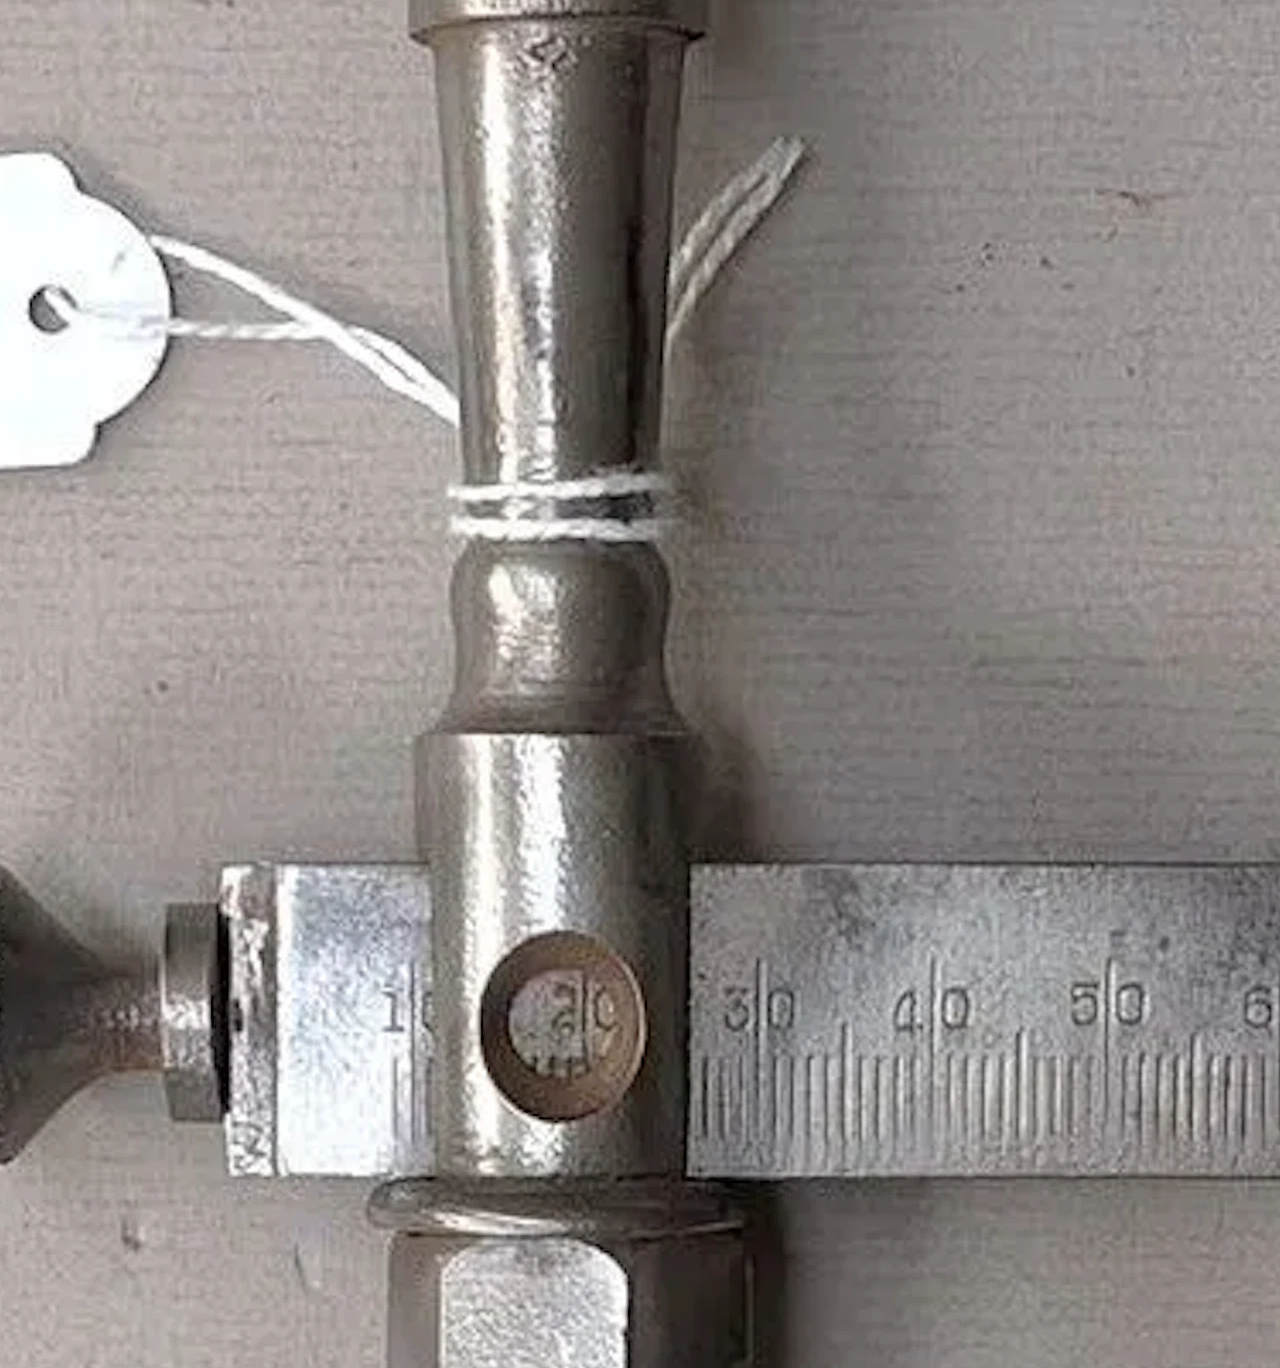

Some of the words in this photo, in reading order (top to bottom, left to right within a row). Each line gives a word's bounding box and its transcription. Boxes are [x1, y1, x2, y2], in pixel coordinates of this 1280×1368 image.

[724, 986, 794, 1030] 30
[893, 987, 970, 1032] 40
[1070, 982, 1147, 1027] 50
